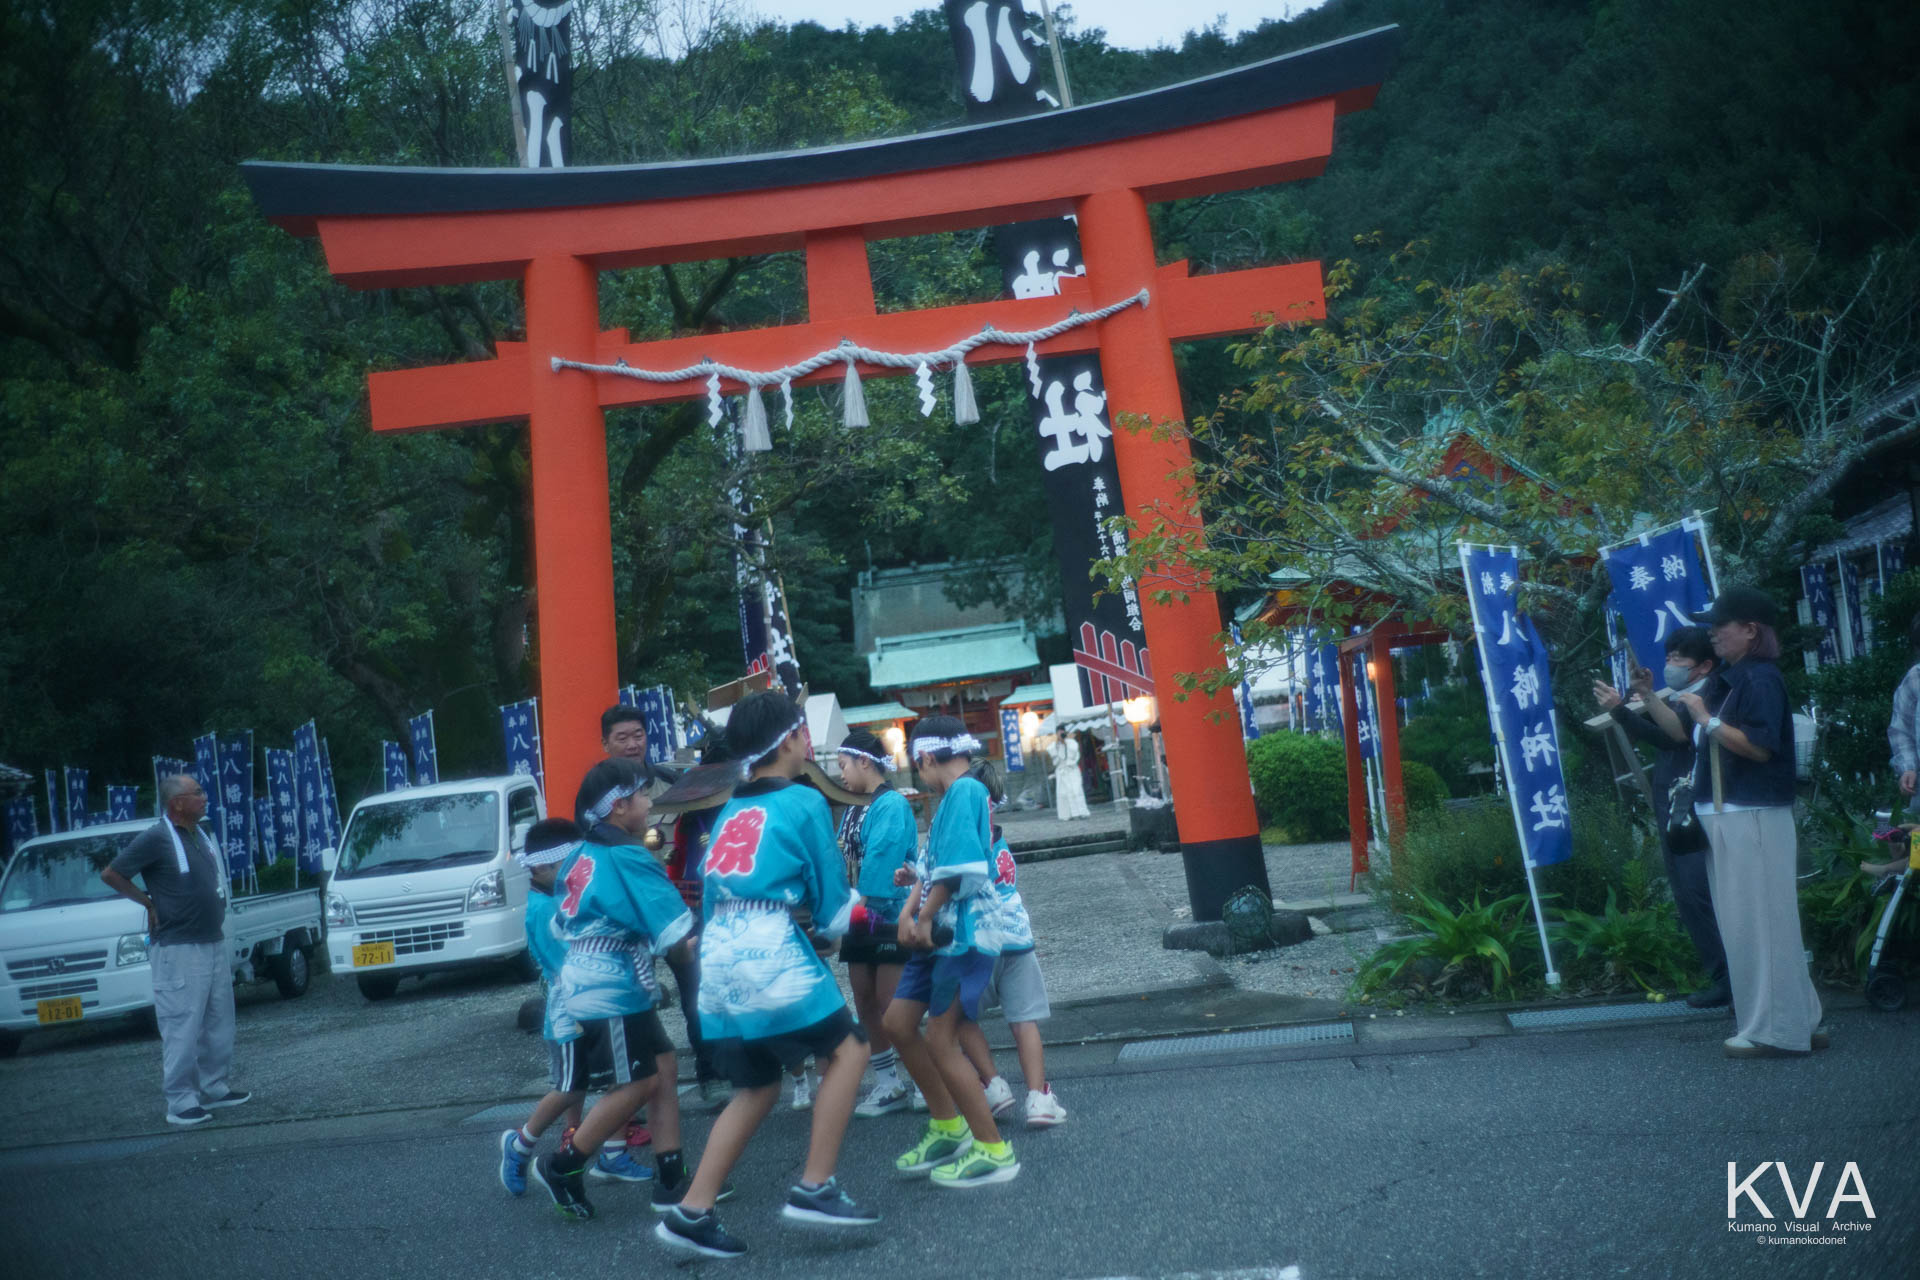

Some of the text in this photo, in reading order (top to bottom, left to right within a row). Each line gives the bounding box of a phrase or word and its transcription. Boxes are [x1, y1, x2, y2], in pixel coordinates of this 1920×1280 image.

[1629, 554, 1687, 592] 奉納
[1654, 600, 1696, 643] 八
[223, 758, 247, 857] 八幡神社
[361, 951, 391, 964] 72-11
